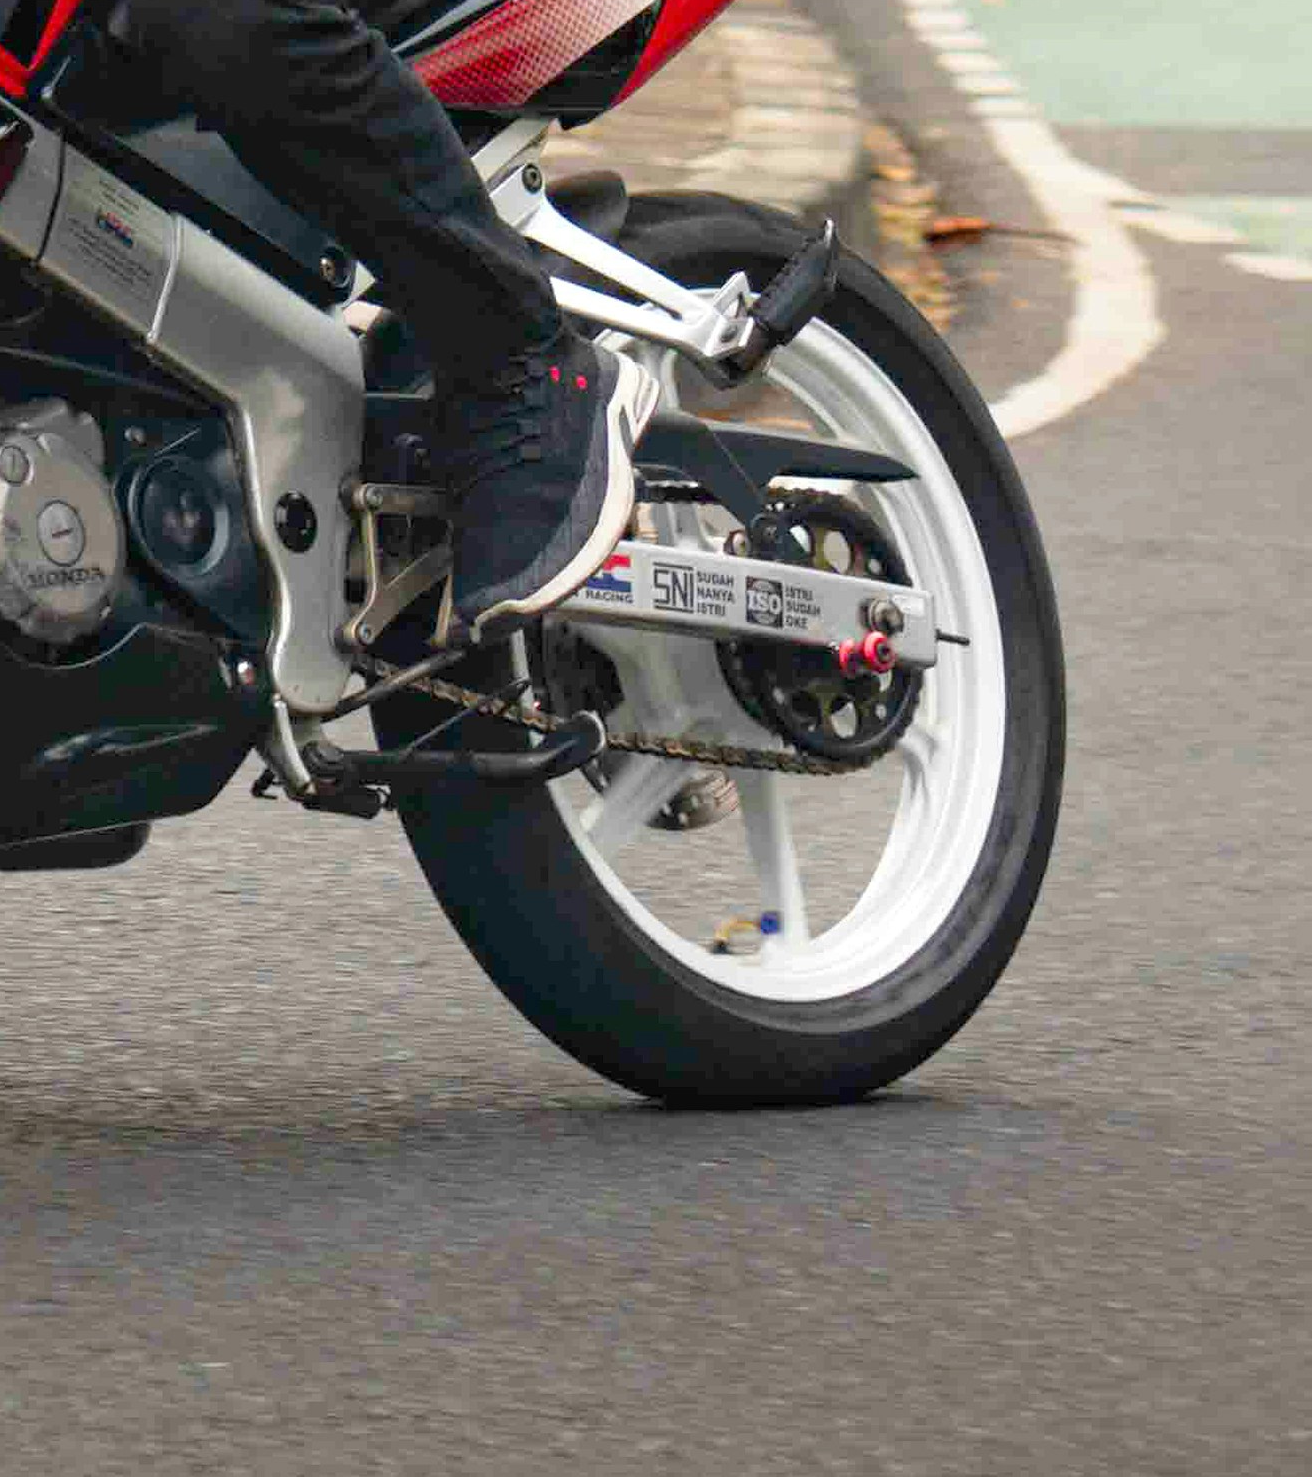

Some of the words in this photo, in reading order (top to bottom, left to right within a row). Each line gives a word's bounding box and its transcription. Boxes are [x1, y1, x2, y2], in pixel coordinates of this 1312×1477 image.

[28, 566, 106, 588] HONDA
[697, 572, 735, 586] SUDAH
[586, 590, 633, 604] RACING
[653, 566, 694, 610] SNI
[697, 602, 726, 617] ISTRI
[747, 590, 782, 615] ISO
